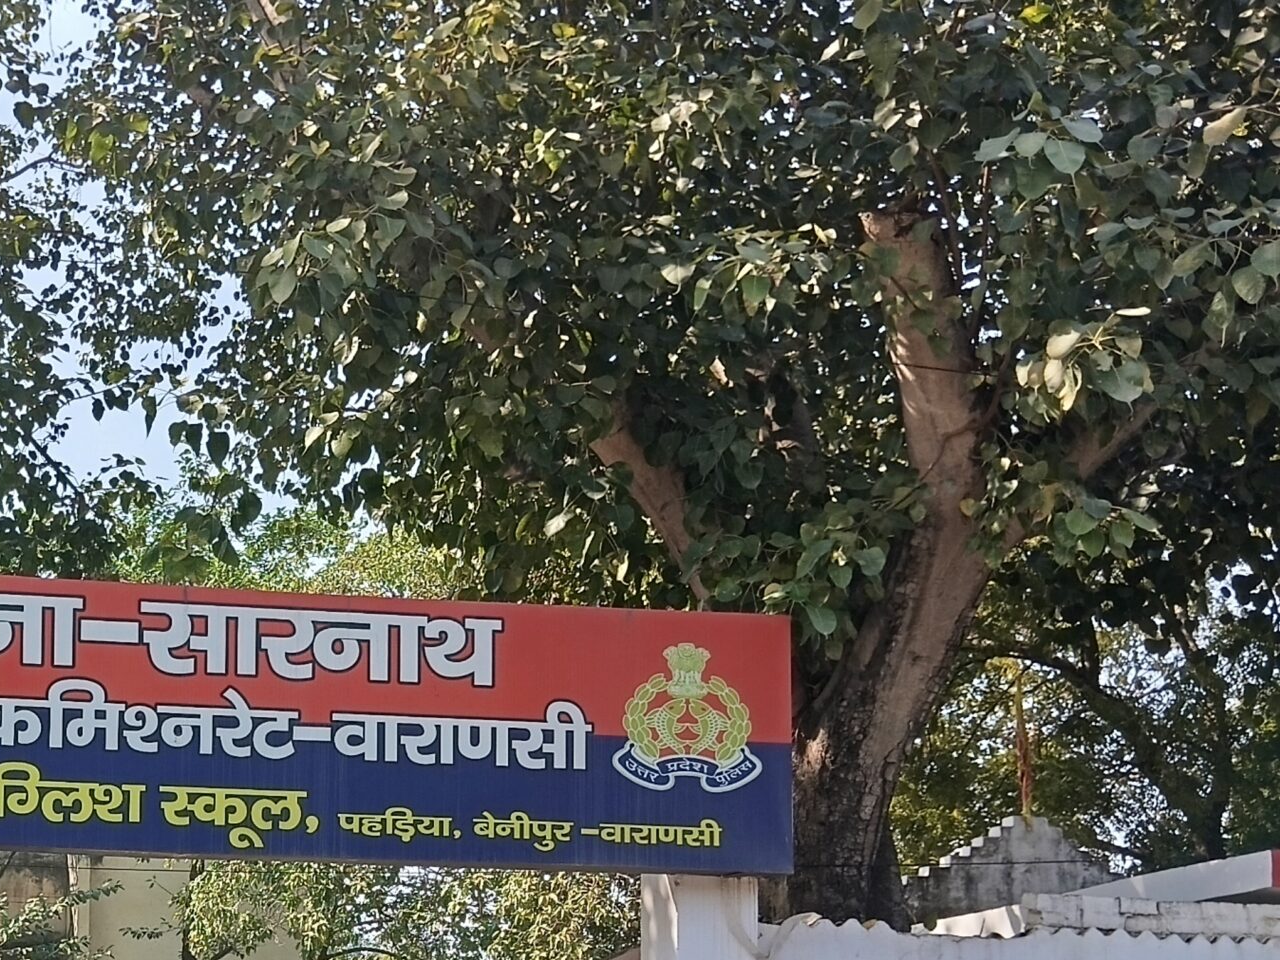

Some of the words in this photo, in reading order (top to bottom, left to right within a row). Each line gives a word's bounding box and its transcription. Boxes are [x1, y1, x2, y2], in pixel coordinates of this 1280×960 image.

[625, 758, 660, 783] उत्तर
[665, 757, 708, 774] प्रदेश
[715, 760, 753, 787] पुलिस
[159, 784, 320, 850] स्कूल,
[336, 806, 463, 843] पहड़िया,
[472, 811, 574, 853] बेनीपुर
